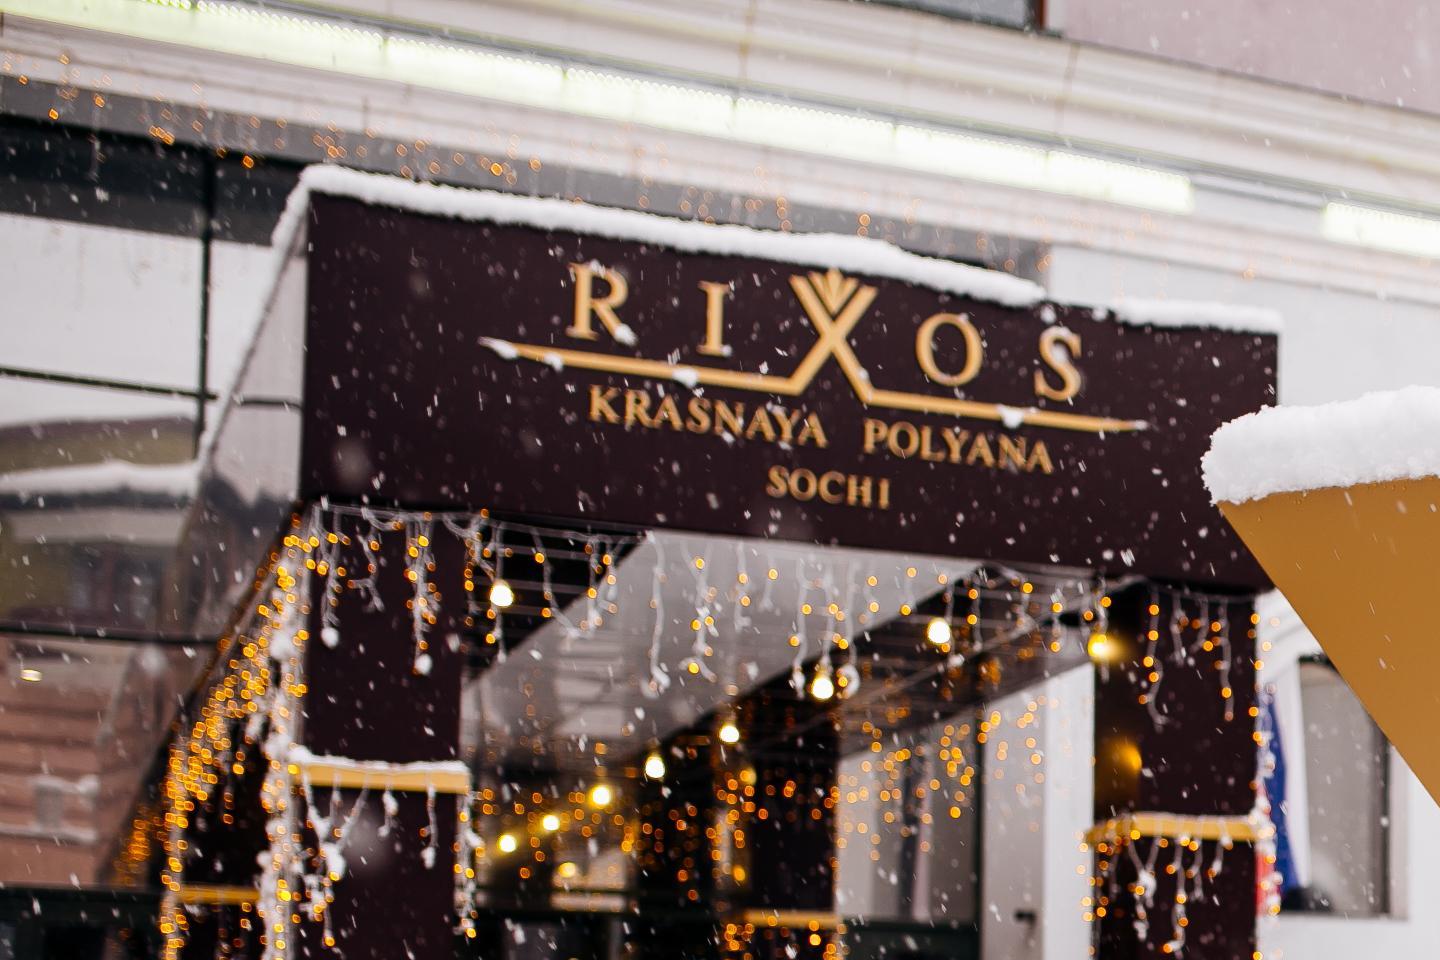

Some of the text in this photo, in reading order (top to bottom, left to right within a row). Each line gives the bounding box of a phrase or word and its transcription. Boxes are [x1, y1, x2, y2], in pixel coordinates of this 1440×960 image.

[567, 262, 1083, 402] RIXOS
[588, 384, 1055, 474] KRASNAYA POLYANA
[766, 466, 891, 510] SOCHI
